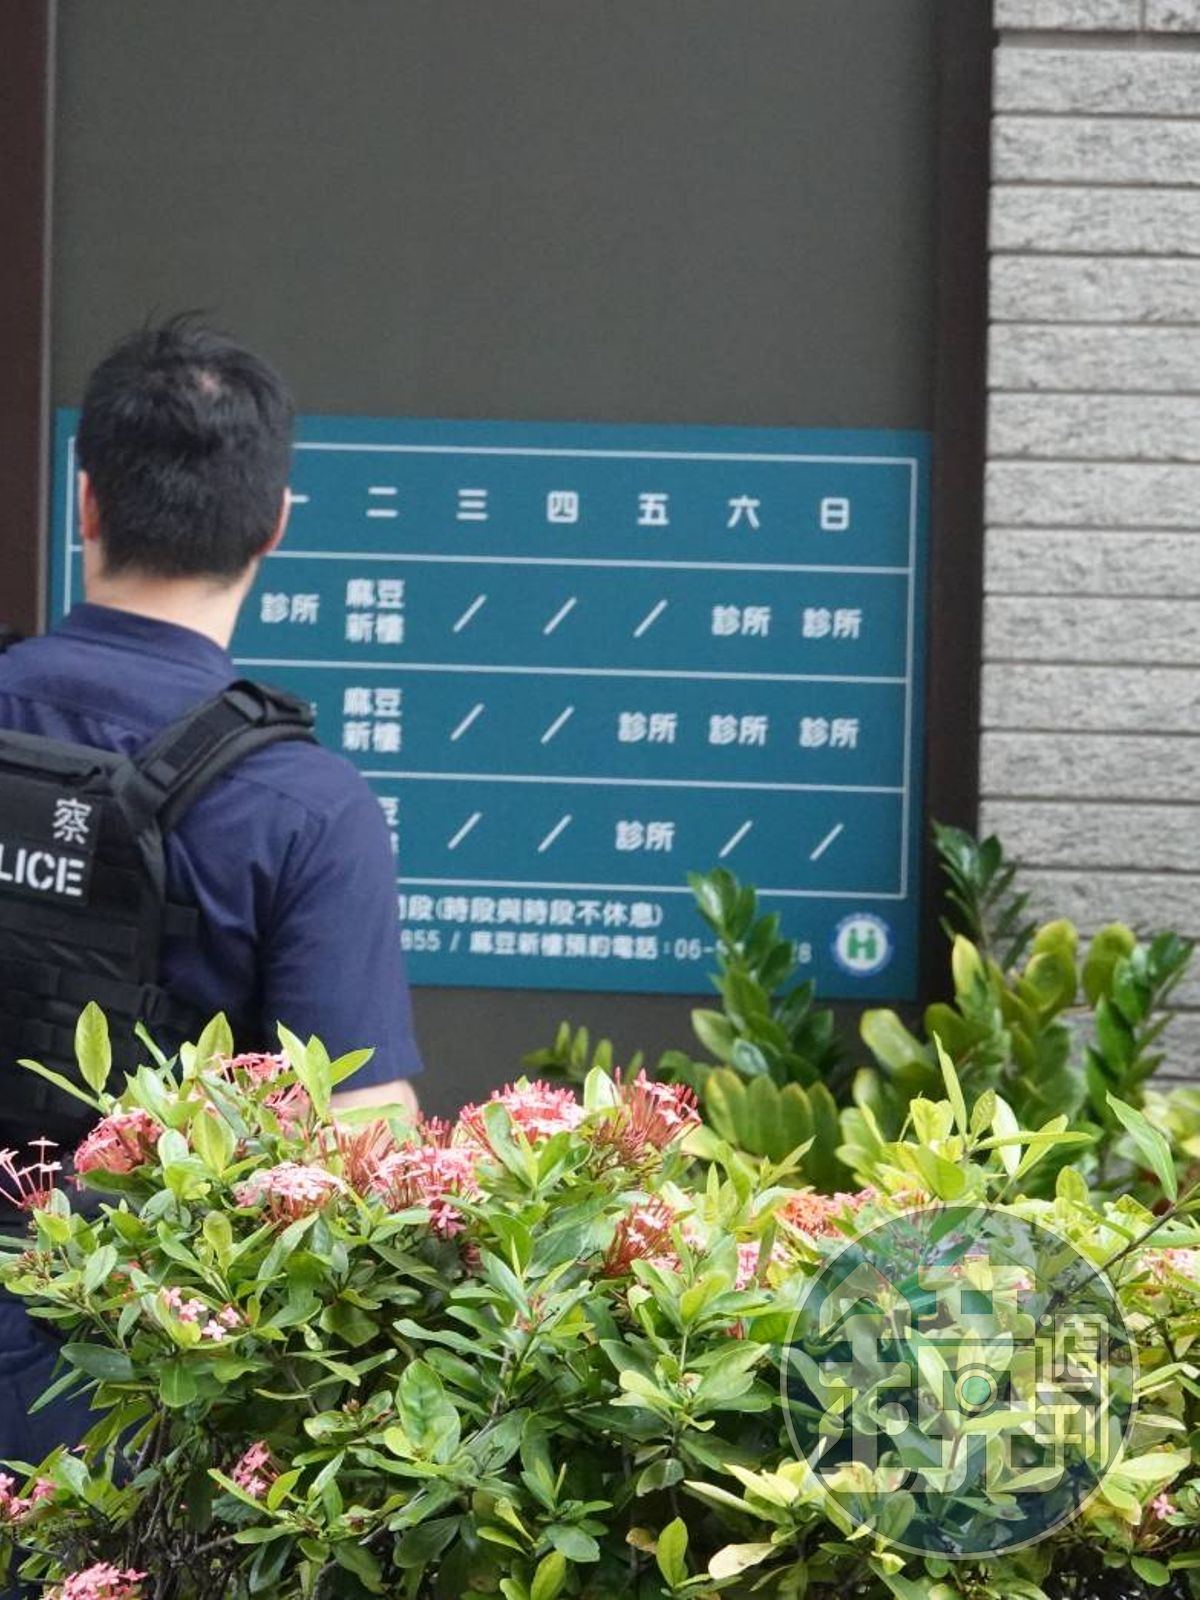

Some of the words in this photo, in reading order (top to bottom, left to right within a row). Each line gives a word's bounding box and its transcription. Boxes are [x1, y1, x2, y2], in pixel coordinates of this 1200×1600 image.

[366, 486, 399, 518] 二
[456, 488, 489, 521] 三
[546, 490, 580, 524] 四
[636, 493, 670, 526] 五
[727, 495, 761, 529] 六
[820, 497, 850, 531] 日
[260, 592, 320, 625] 診所
[711, 605, 771, 638] 診所
[801, 607, 863, 640] 診所
[617, 711, 678, 744] 診所
[708, 714, 769, 746] 診所
[799, 717, 860, 749] 診所
[614, 820, 676, 853] 診所
